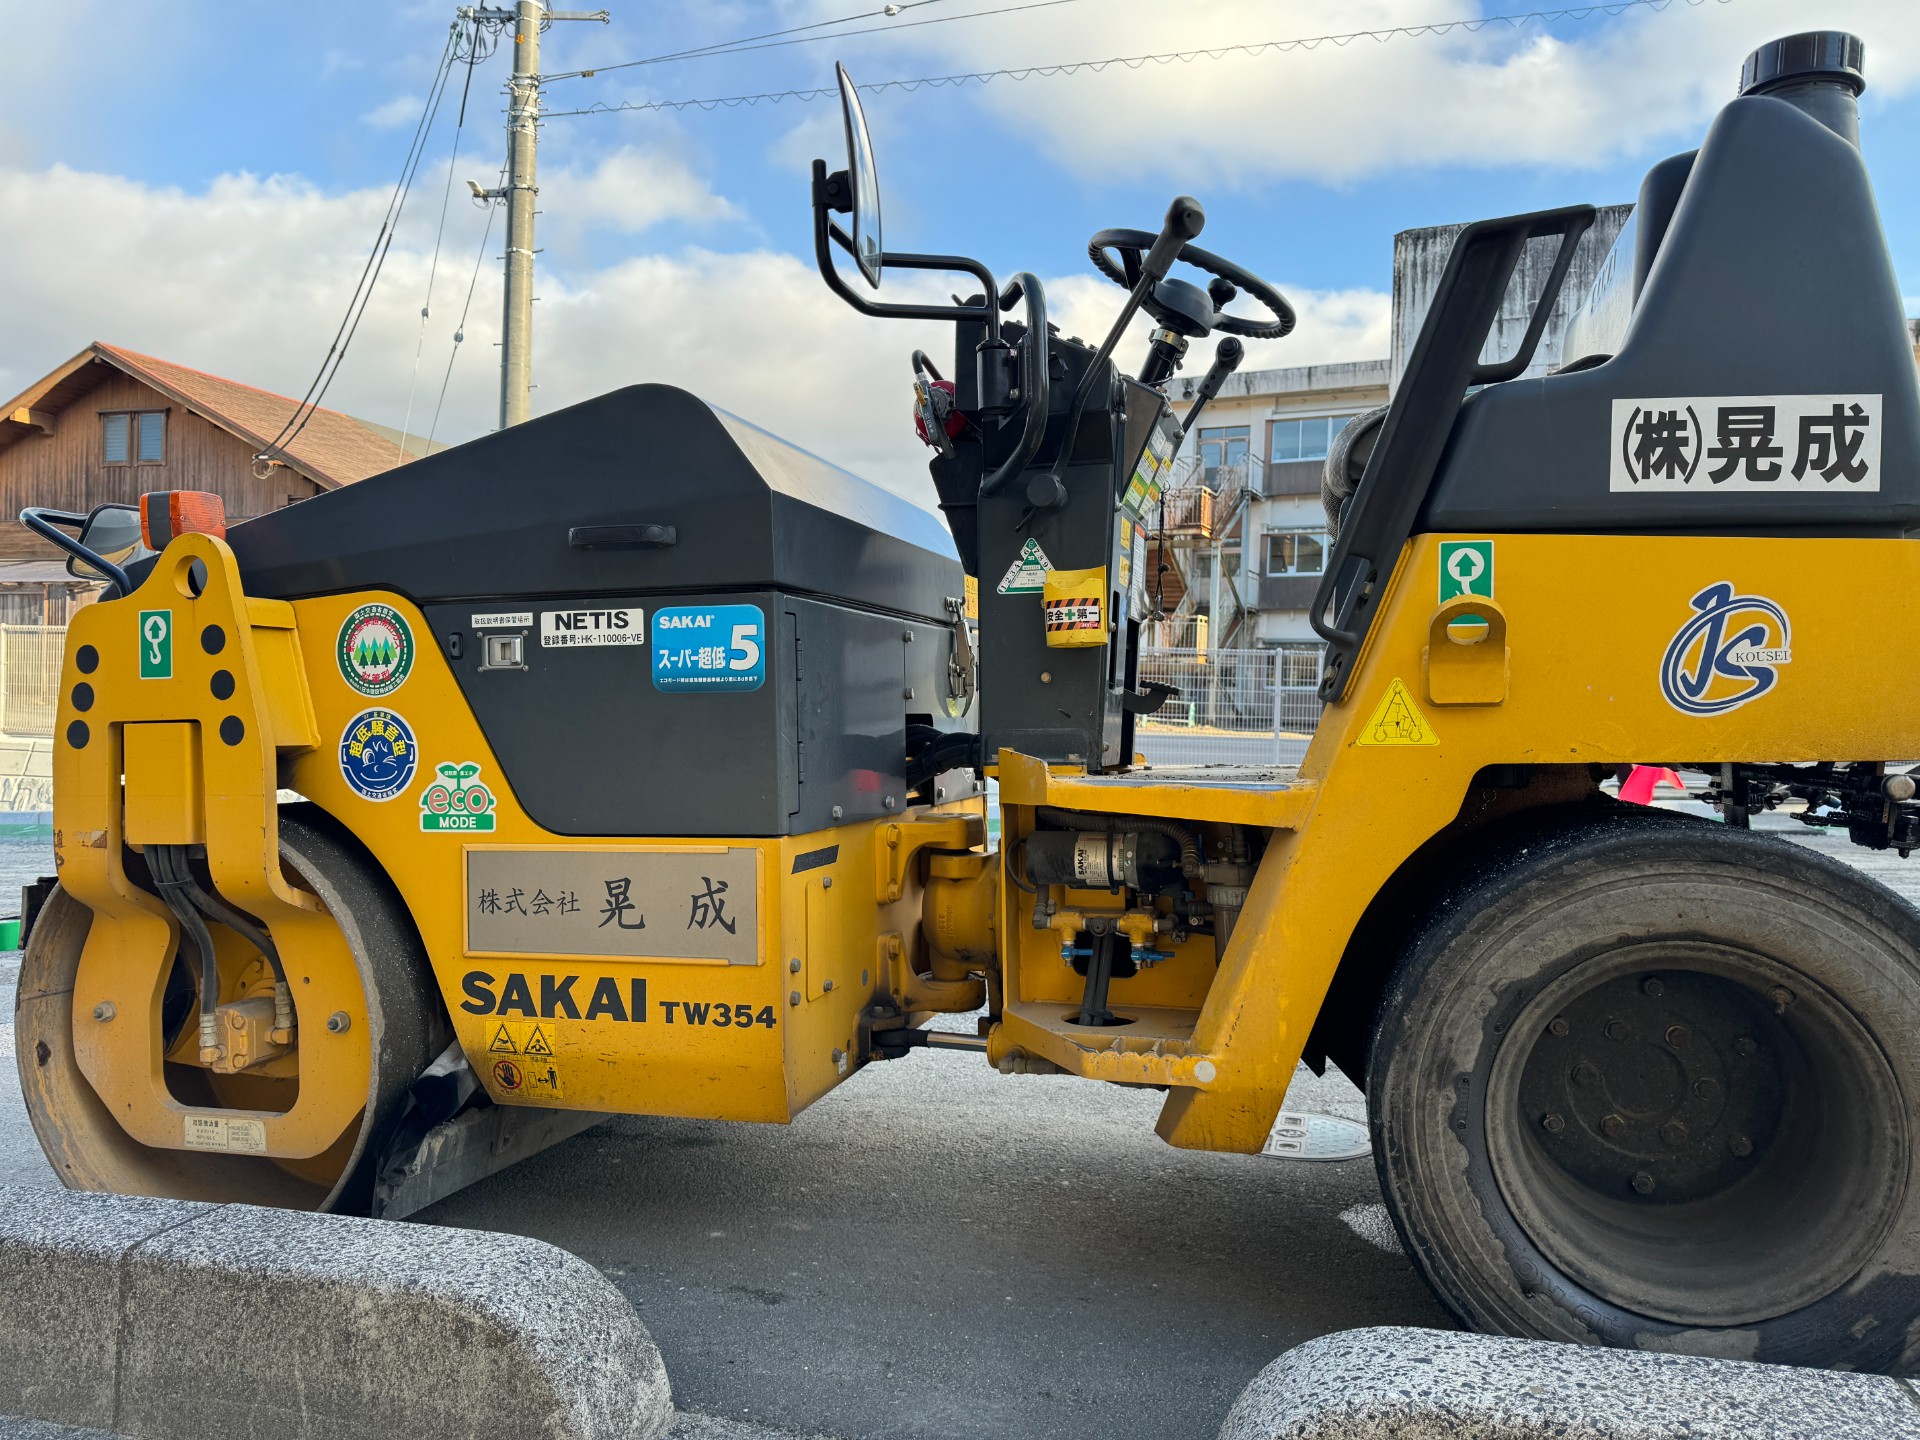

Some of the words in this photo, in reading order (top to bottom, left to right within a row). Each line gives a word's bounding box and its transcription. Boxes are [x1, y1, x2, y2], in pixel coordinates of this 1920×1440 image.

[555, 610, 629, 631] NETIS
[659, 615, 711, 629] SAKAI
[729, 624, 760, 671] 5
[1735, 650, 1789, 663] KOUSEI
[349, 720, 407, 758] 超低騒音型
[428, 787, 488, 813] eco
[439, 816, 477, 828] MODE
[1077, 849, 1085, 876] SAKAI
[477, 887, 581, 916] 株式会社
[459, 970, 647, 1023] SAKAI
[659, 1000, 777, 1029] TW354
